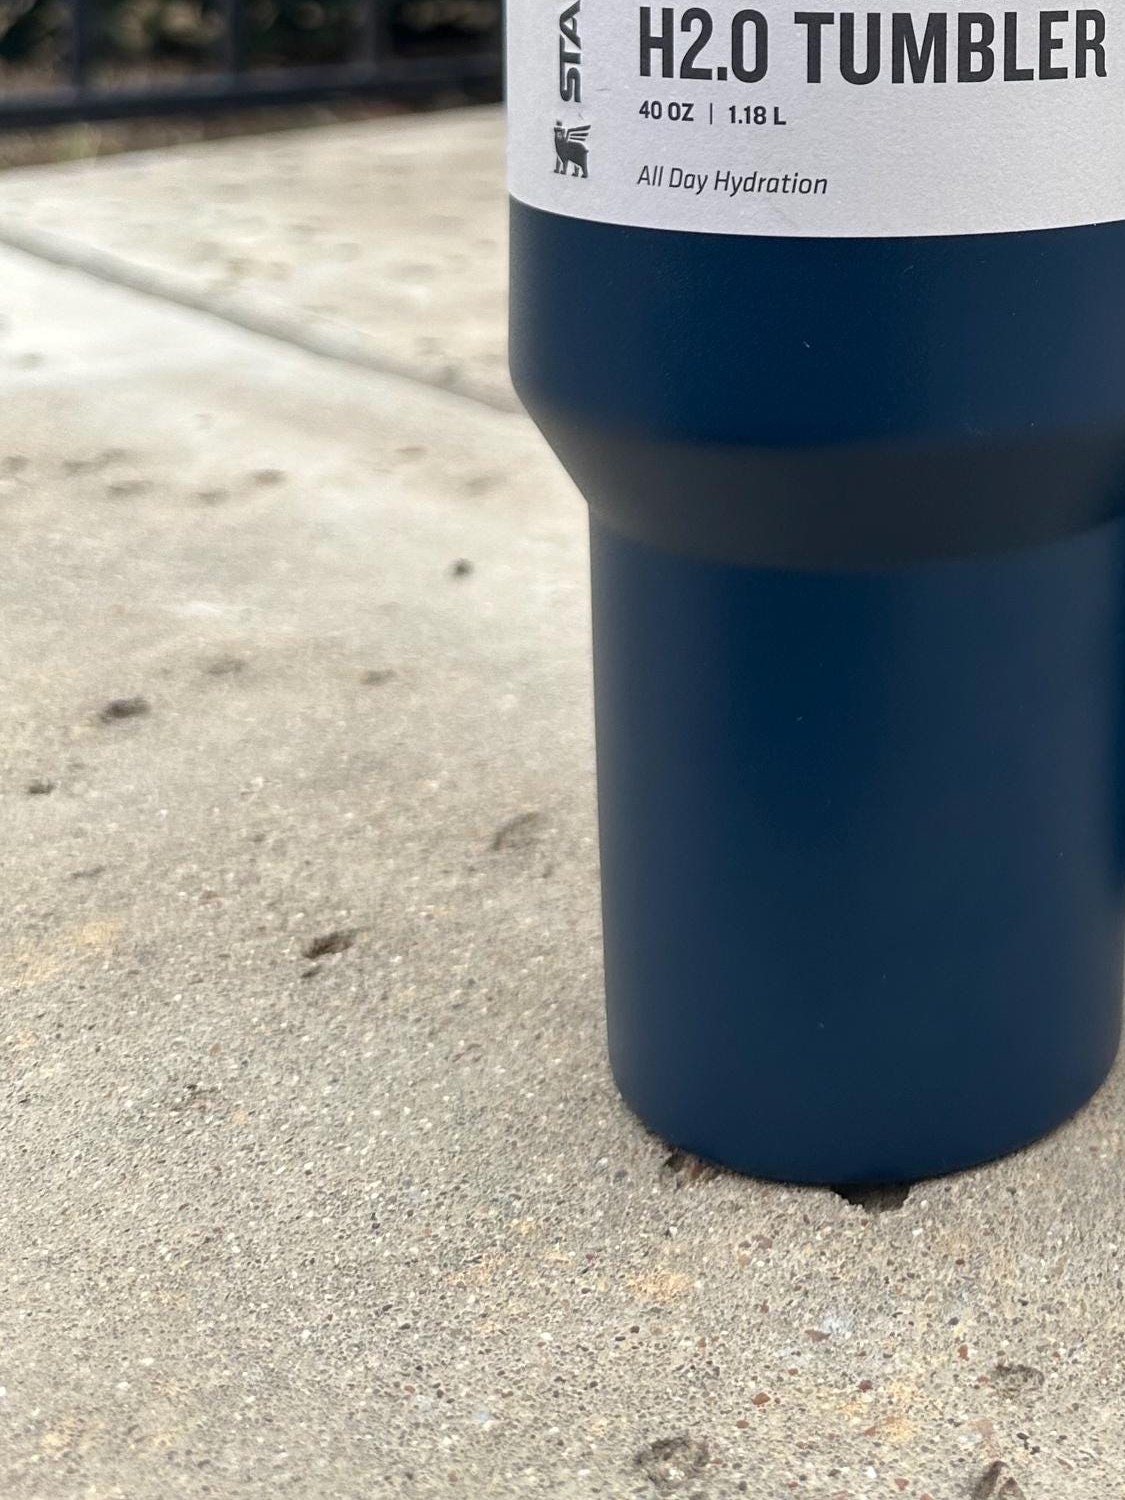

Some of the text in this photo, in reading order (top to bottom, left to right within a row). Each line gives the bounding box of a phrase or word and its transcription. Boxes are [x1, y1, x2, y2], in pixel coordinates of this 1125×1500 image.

[794, 9, 1108, 85] TUMBLER
[638, 100, 787, 125] 40 OZ 1.18 L
[637, 165, 828, 198] All Day Hydration
